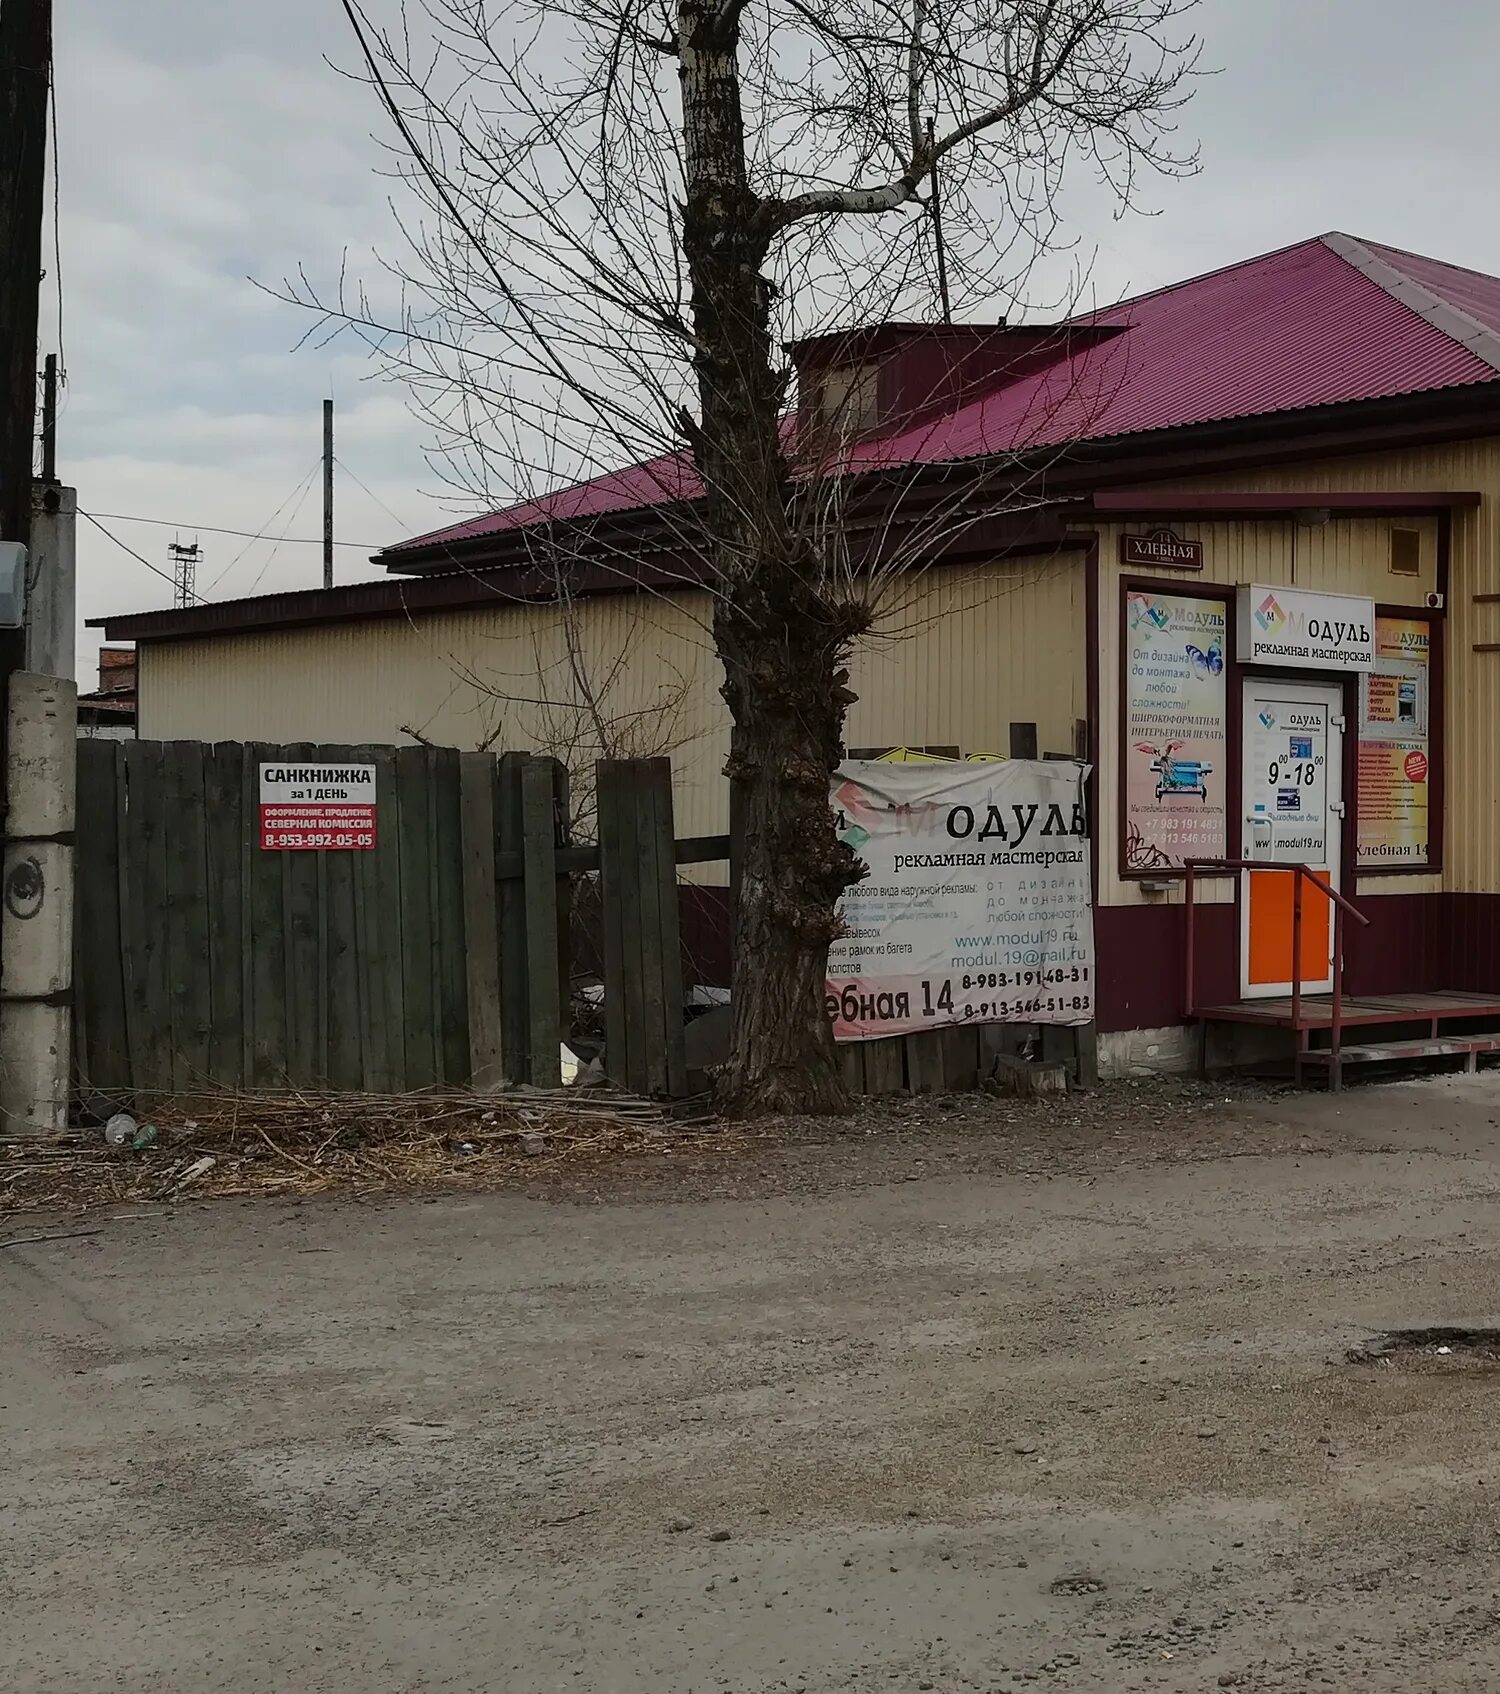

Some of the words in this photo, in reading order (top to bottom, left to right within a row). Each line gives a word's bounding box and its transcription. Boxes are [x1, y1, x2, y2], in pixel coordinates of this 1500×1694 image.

[1160, 533, 1171, 543] 14
[1135, 541, 1194, 559] ХЛЕБНАЯ
[1174, 608, 1224, 627] Модуль
[1133, 648, 1149, 660] От
[1151, 649, 1190, 664] дизайна
[1254, 641, 1309, 657] рекламная
[1311, 649, 1372, 664] мастерская
[1132, 664, 1144, 676] до
[1146, 667, 1191, 679] монтажа
[1145, 682, 1177, 694] любой
[1131, 713, 1220, 727] ШИРОКОФОРМАТНАЯ
[1131, 727, 1191, 739] ИНТЕРЬЕРНАЯ
[1192, 730, 1224, 741] ПЕЧАТЬ
[264, 769, 371, 783] САНКНИЖКА
[291, 790, 304, 799] за
[306, 789, 312, 798] 1
[314, 788, 348, 800] ДЕНЬ
[325, 808, 372, 817] ПРОДЛЕНИЕ
[265, 819, 317, 828] СЕВЕРНАЯ
[318, 819, 372, 829] КОМИССИЯ
[1160, 819, 1179, 830] 983
[1181, 819, 1197, 829] 191
[265, 834, 373, 846] 8-953-992-05-05
[1160, 833, 1179, 843] 913
[1180, 833, 1198, 844] 546
[1255, 838, 1323, 848] ww.modul19.ru
[893, 854, 986, 873] рекламная
[989, 850, 1084, 870] мастерская
[848, 885, 878, 897] любого
[880, 887, 899, 898] вида
[901, 883, 940, 898] наружной
[986, 881, 1004, 891] от
[986, 896, 1006, 909] до
[987, 910, 1025, 922] любой
[846, 927, 881, 939] вывесок
[954, 928, 1079, 948] www.modul19ru
[849, 947, 874, 958] рамок
[876, 946, 885, 955] из
[886, 942, 912, 955] багета
[951, 947, 1087, 969] modul.19@mail.ru
[962, 968, 1089, 989] 8-983-191-48-31
[824, 984, 911, 1022] ебная
[921, 979, 955, 1016] 14
[964, 996, 1090, 1018] 8-913-546-51-83
